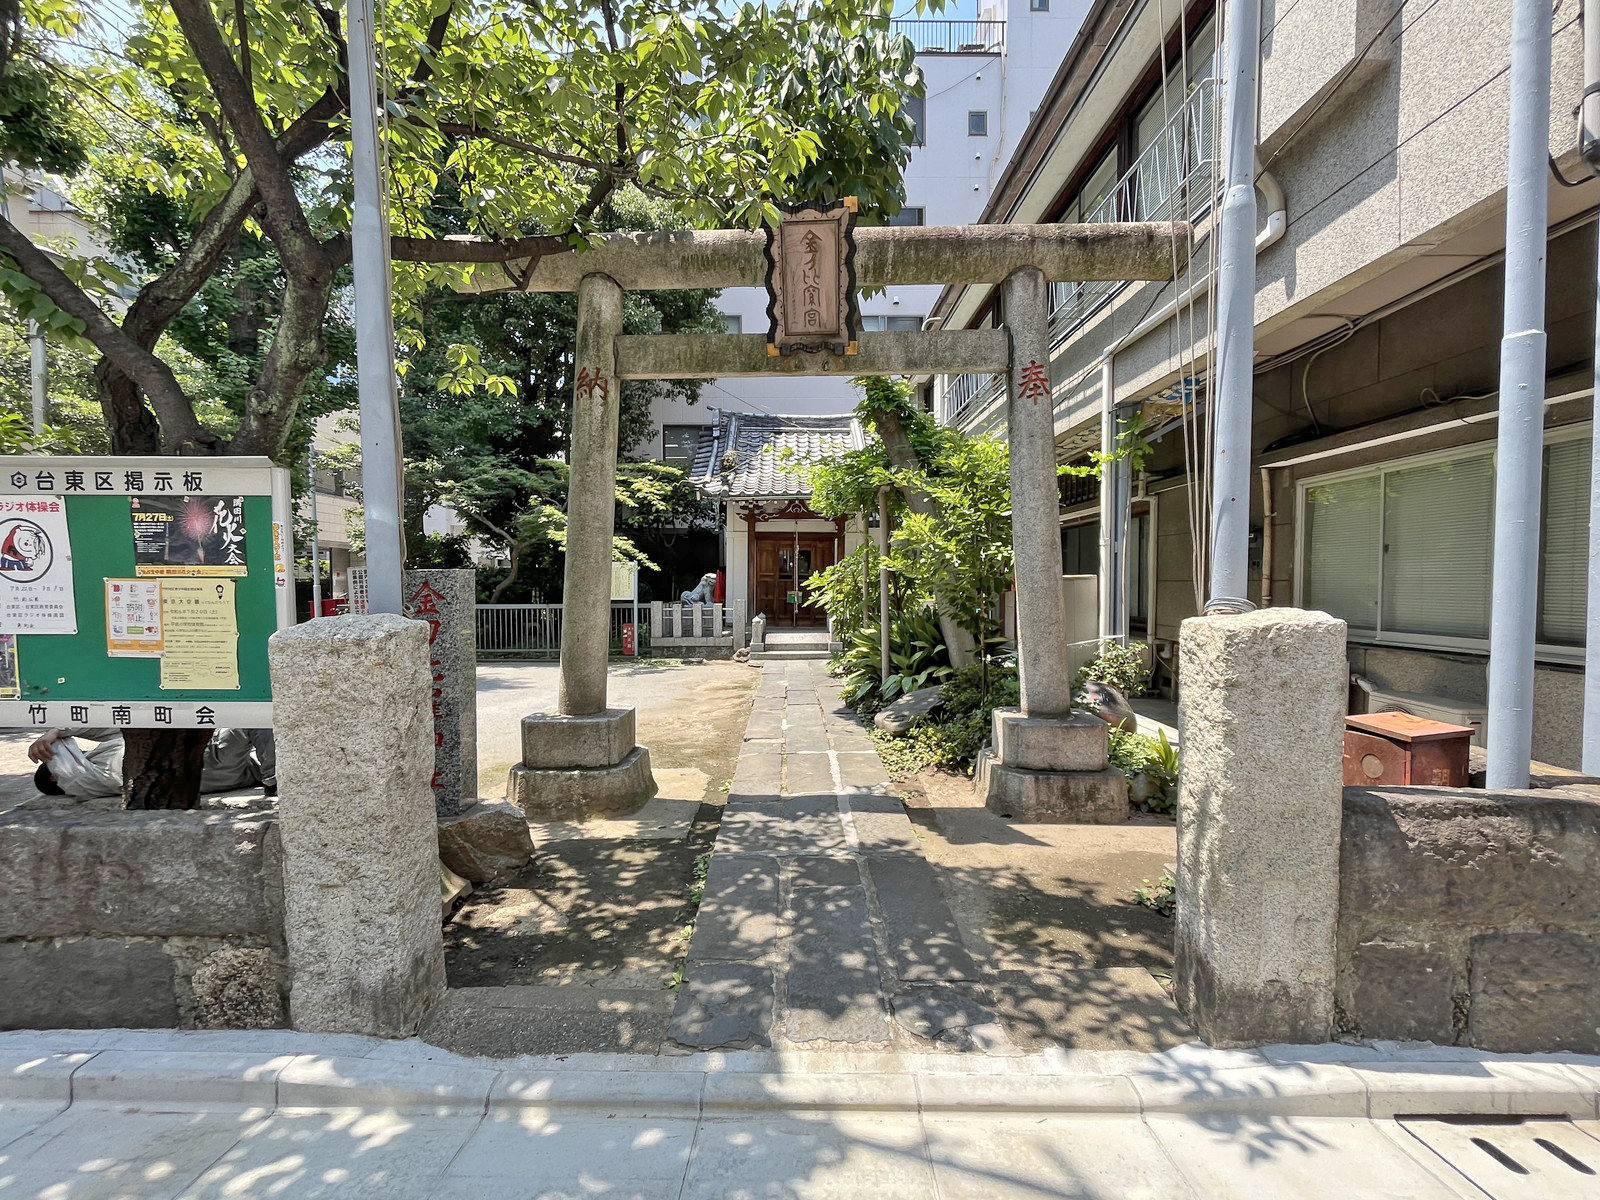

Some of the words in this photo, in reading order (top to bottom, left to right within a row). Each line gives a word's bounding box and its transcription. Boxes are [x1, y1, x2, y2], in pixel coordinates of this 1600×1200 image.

[576, 366, 609, 401] 納
[1018, 360, 1050, 405] 奉
[35, 470, 203, 492] 台東区掲示板
[209, 500, 245, 565] 花火大会
[28, 704, 215, 725] 竹町南町会
